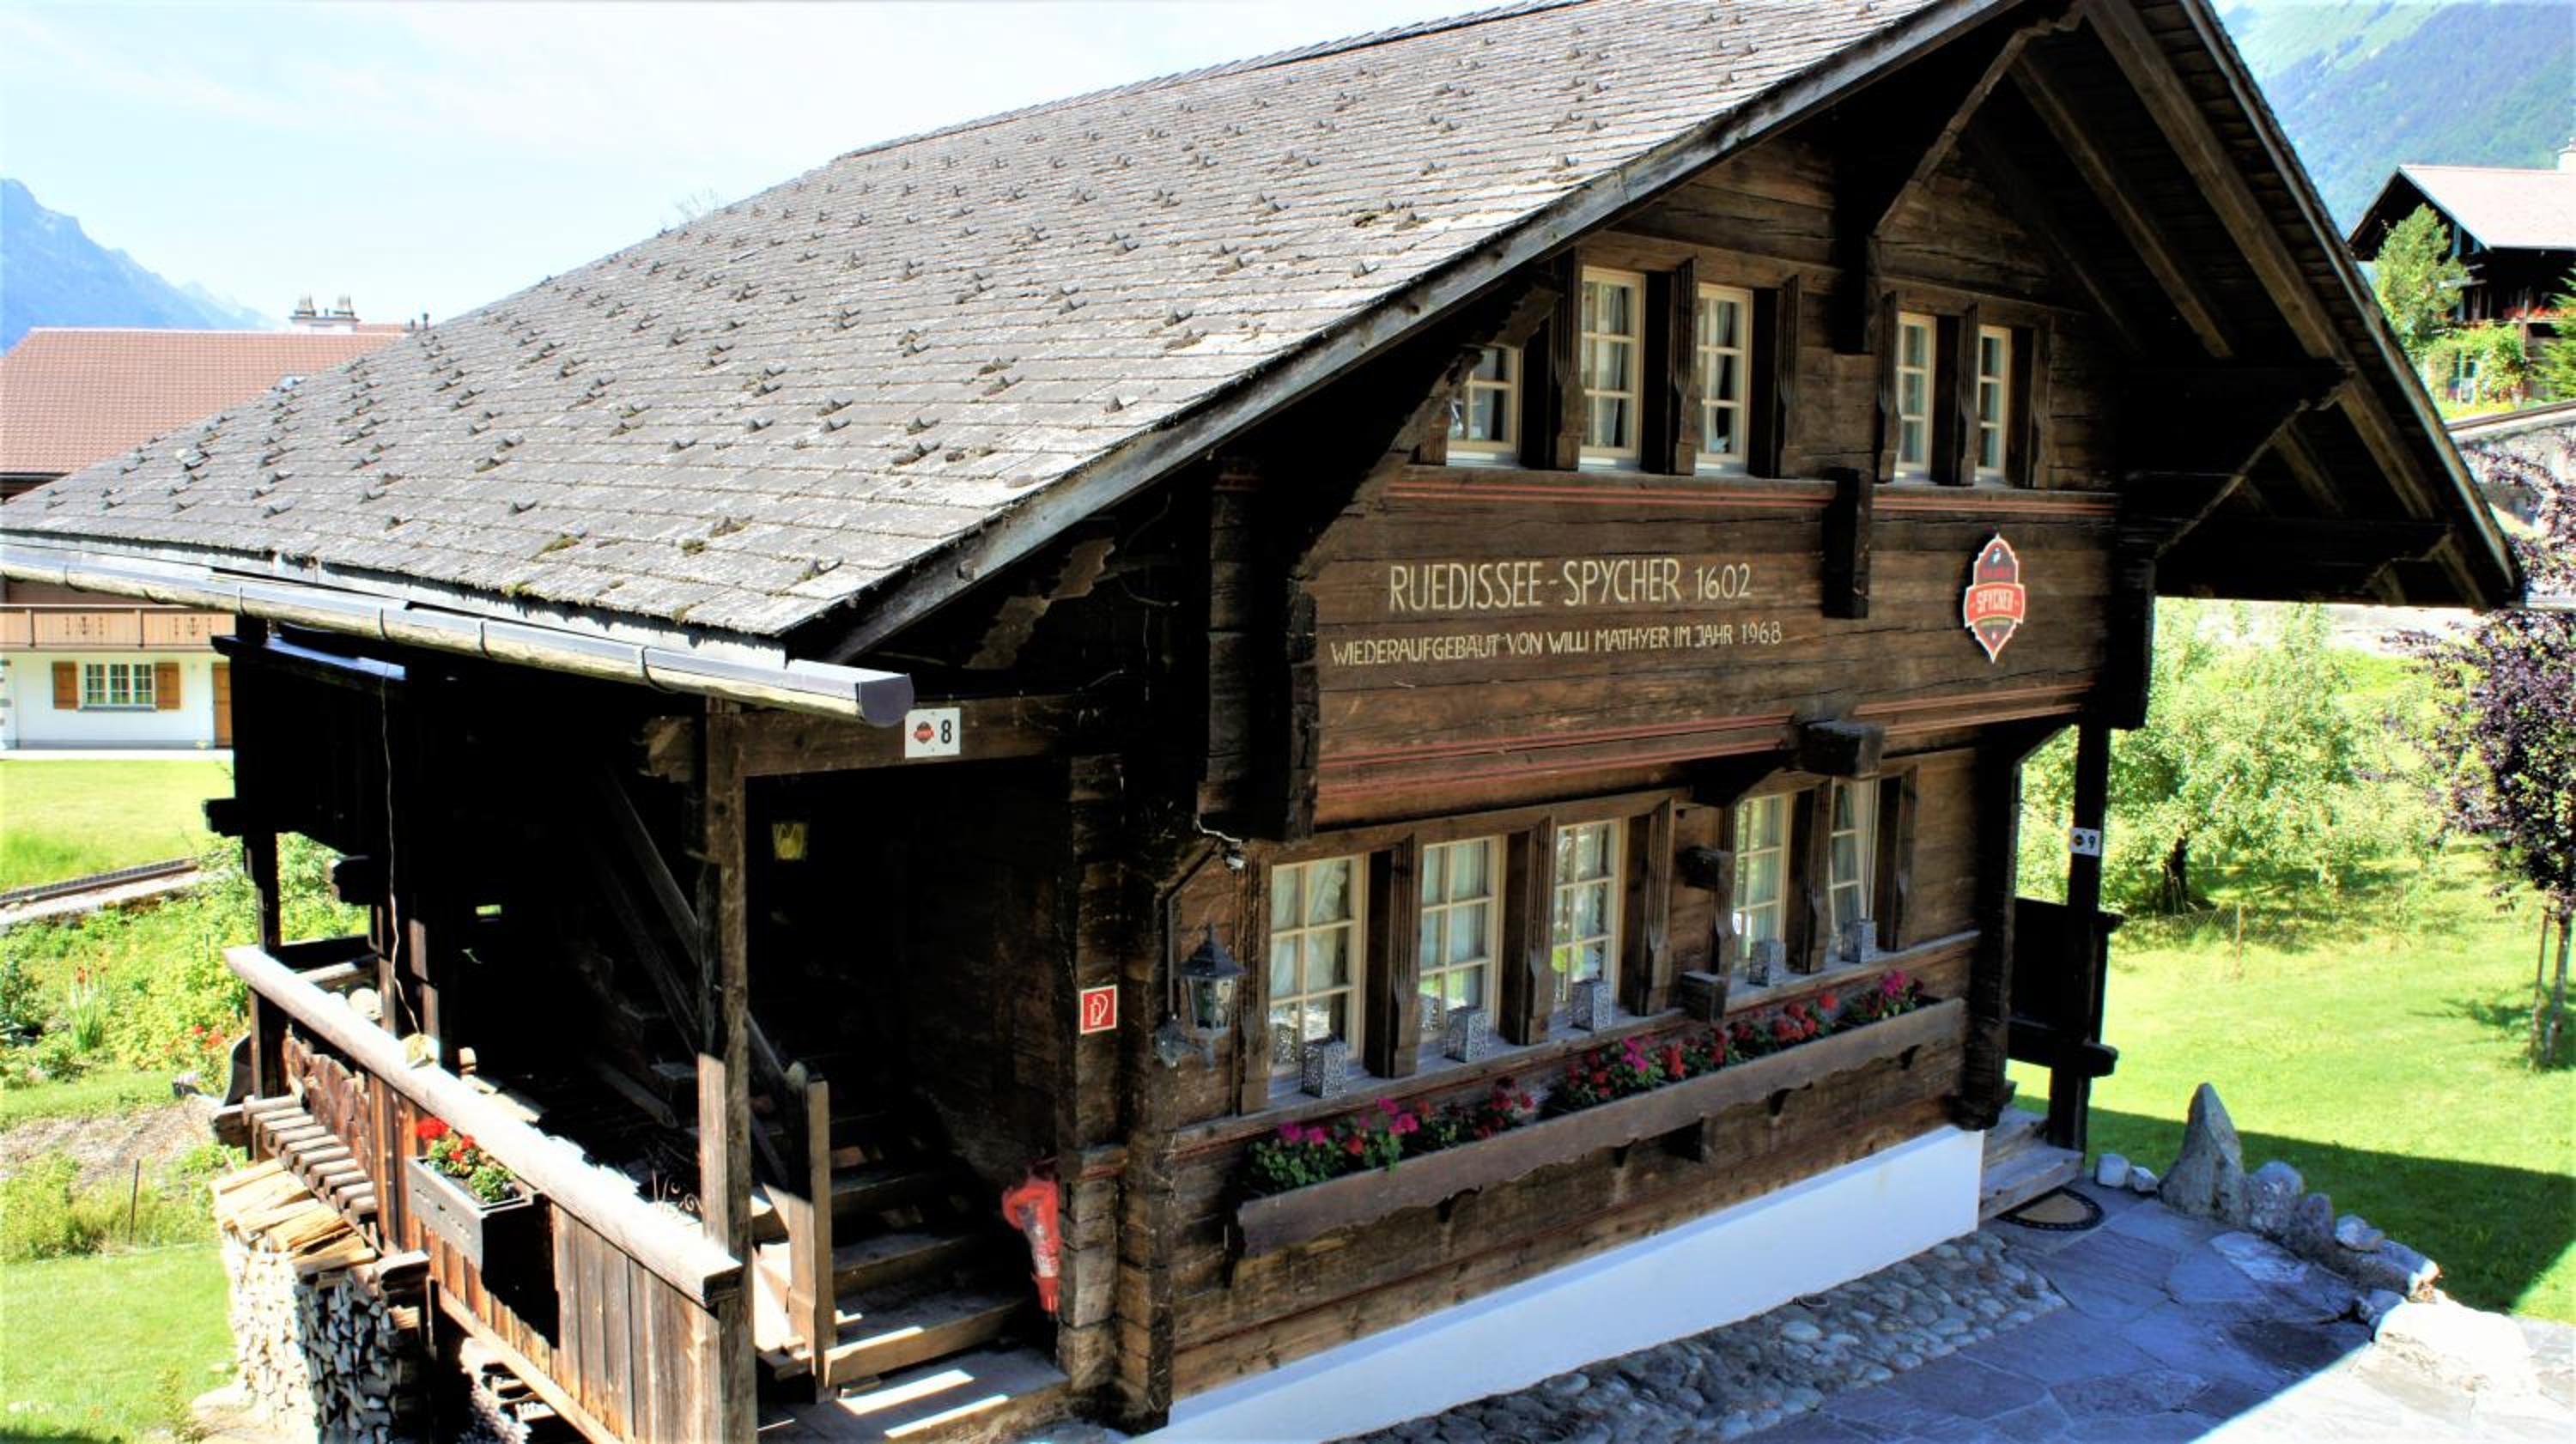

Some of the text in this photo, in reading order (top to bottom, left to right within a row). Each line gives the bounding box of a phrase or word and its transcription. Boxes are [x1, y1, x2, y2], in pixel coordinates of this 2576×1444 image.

[1695, 563, 1753, 602] 1602
[1505, 631, 1543, 656] VON
[1546, 629, 1589, 654] WILLI
[1595, 626, 1669, 653] MATHYER
[1674, 625, 1691, 648] IM
[1694, 623, 1734, 648] JAHR
[1741, 621, 1783, 645] 1968
[941, 719, 952, 744] 8
[2088, 834, 2096, 849] 9
